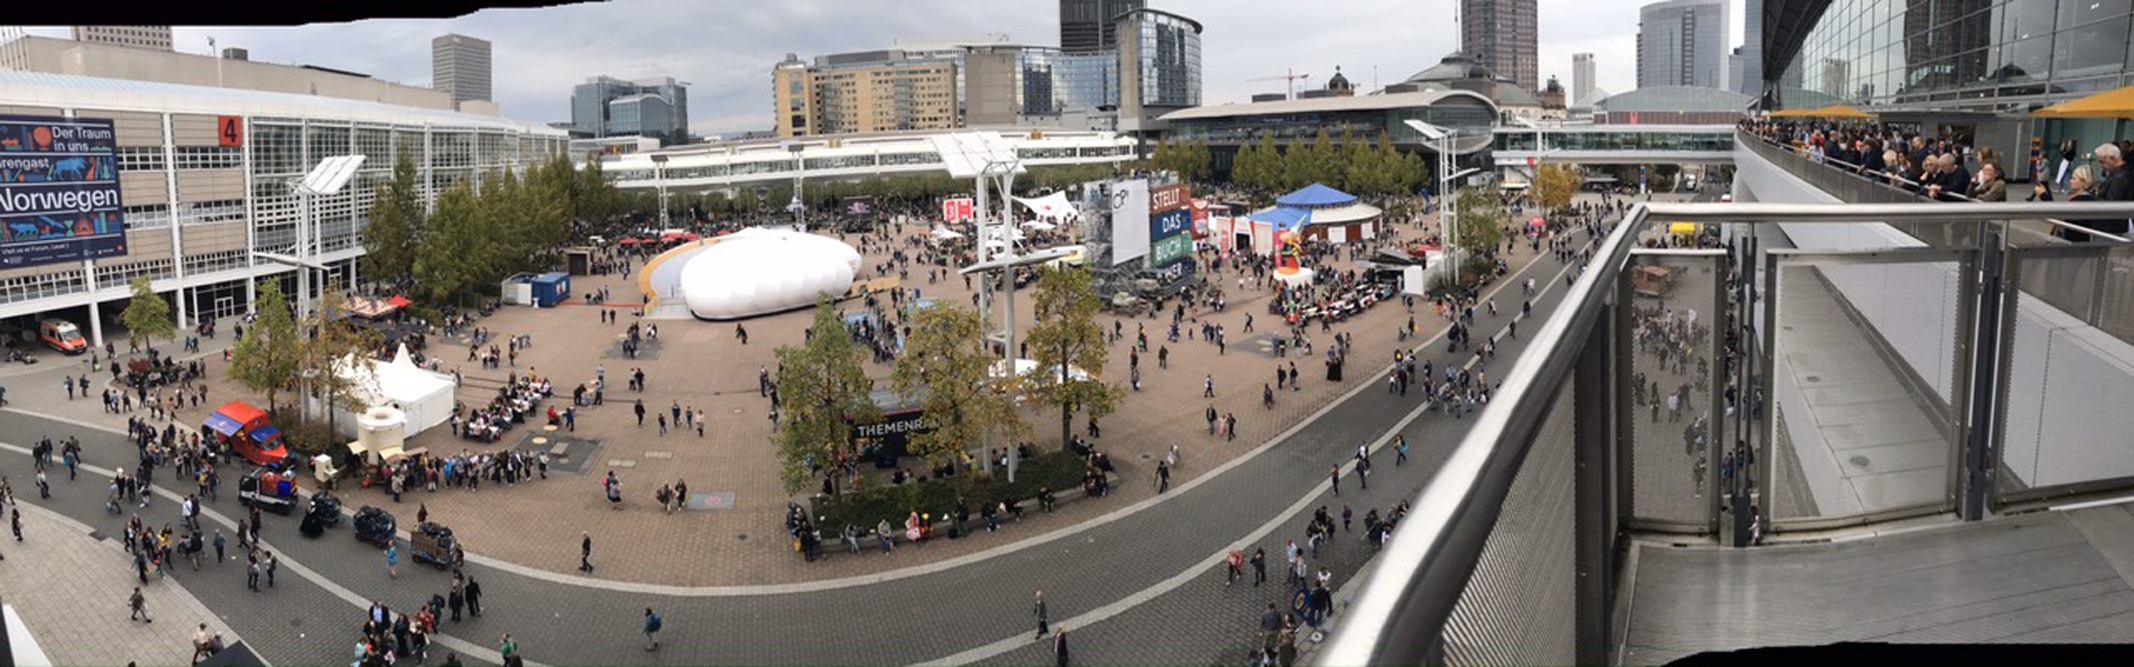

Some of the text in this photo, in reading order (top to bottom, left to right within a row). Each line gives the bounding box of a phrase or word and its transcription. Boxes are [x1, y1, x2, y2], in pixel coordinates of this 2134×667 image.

[52, 126, 112, 139] Der Traum
[224, 119, 238, 143] 4
[54, 140, 89, 152] in uns
[0, 188, 118, 213] Norwegen
[1153, 187, 1180, 210] STELLT
[1162, 213, 1181, 233] DAS
